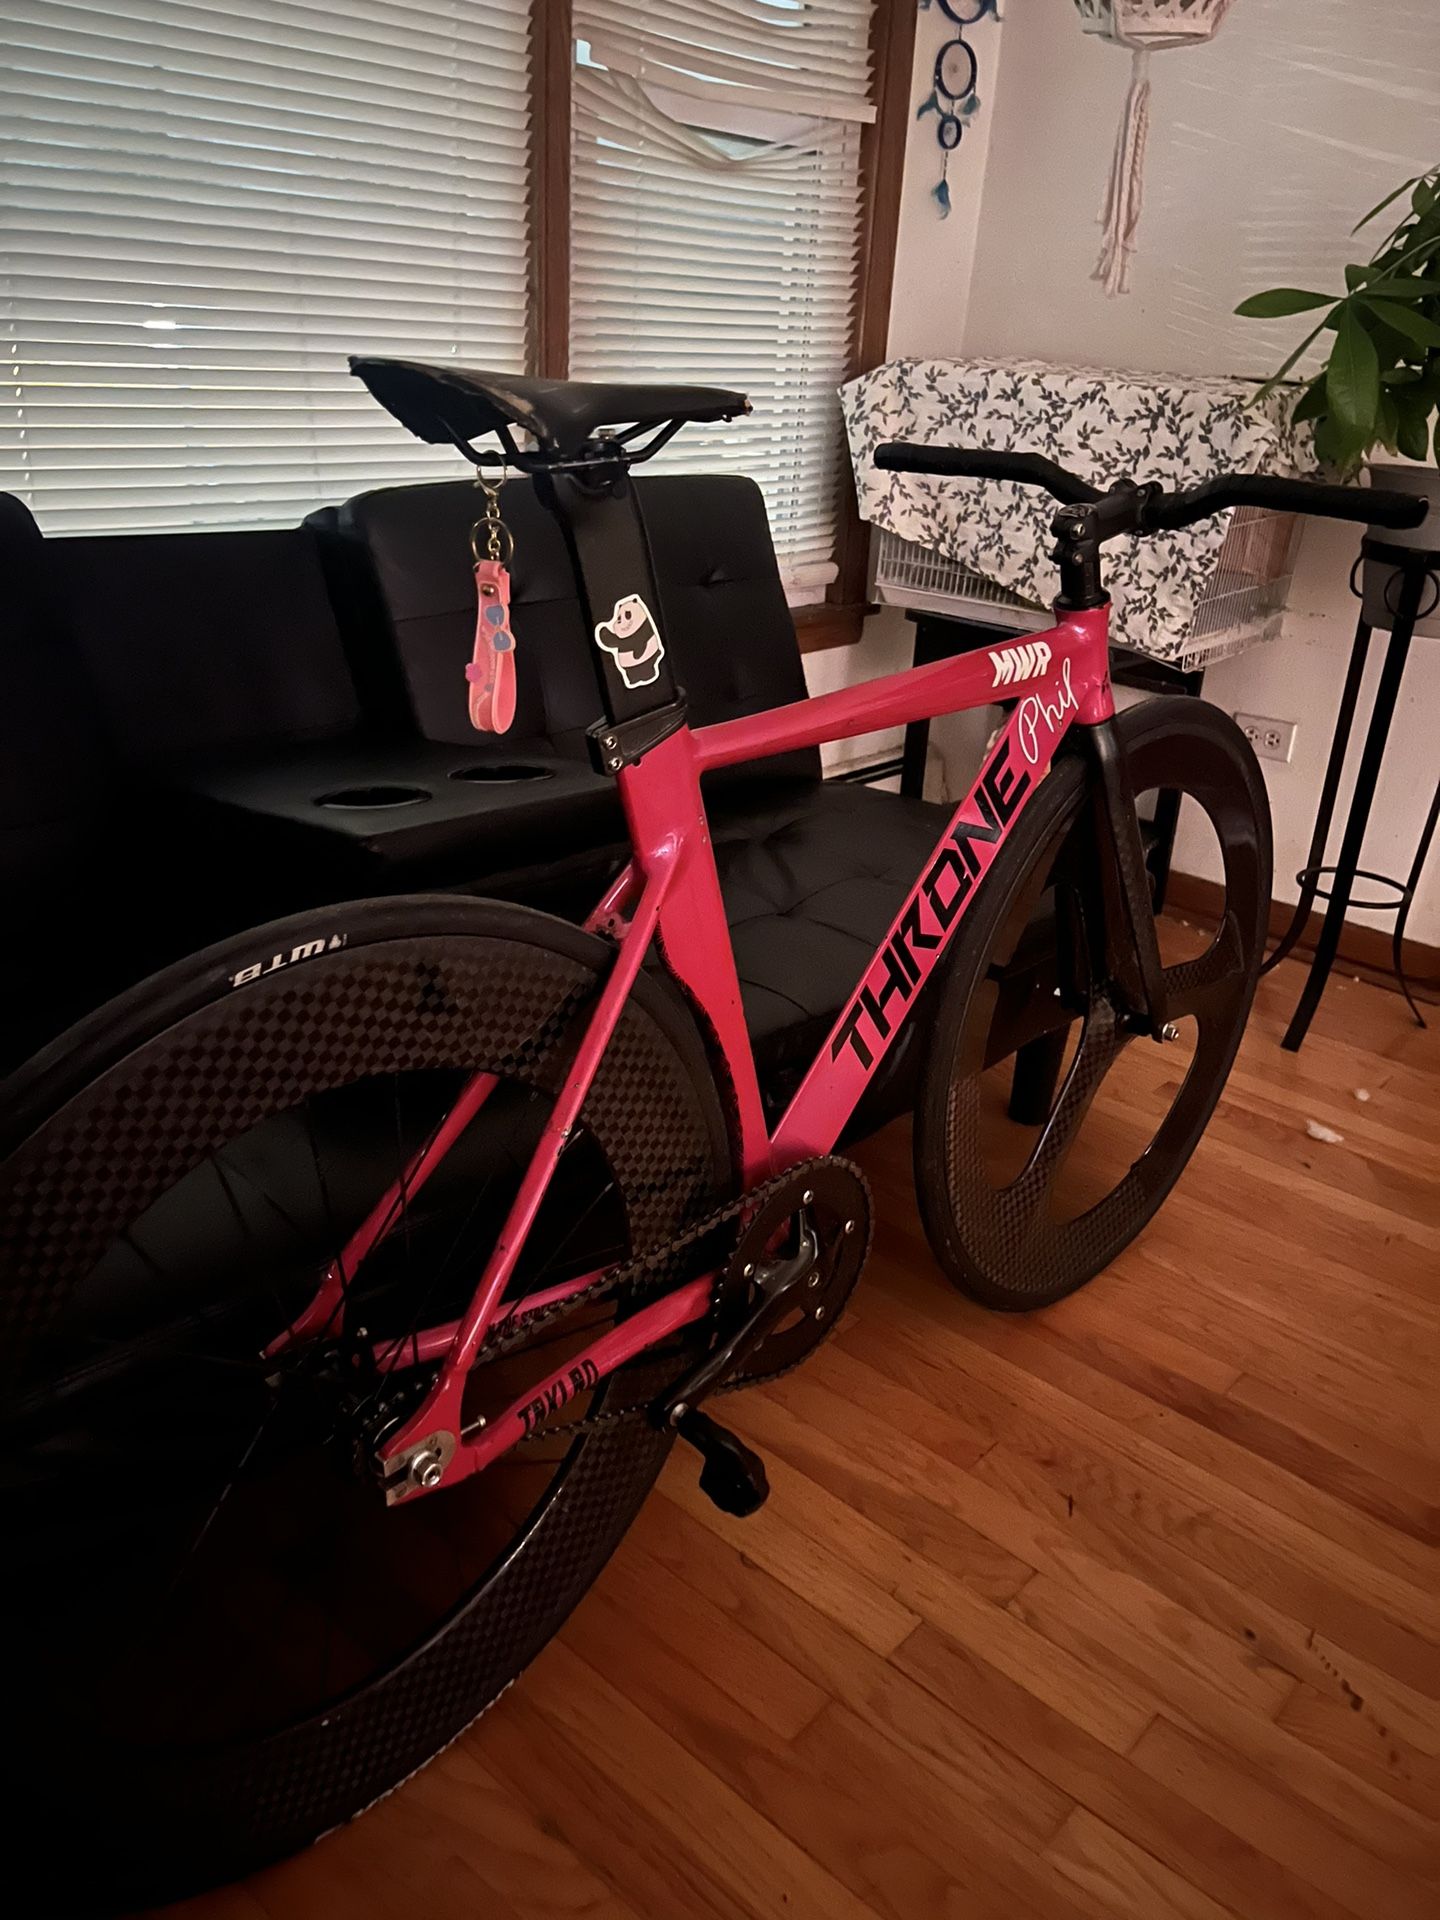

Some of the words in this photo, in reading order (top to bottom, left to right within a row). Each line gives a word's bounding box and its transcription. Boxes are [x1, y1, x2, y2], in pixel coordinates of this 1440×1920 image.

[1018, 657, 1079, 764] Phil
[831, 735, 1032, 1071] THRONE
[232, 938, 326, 988] WTB
